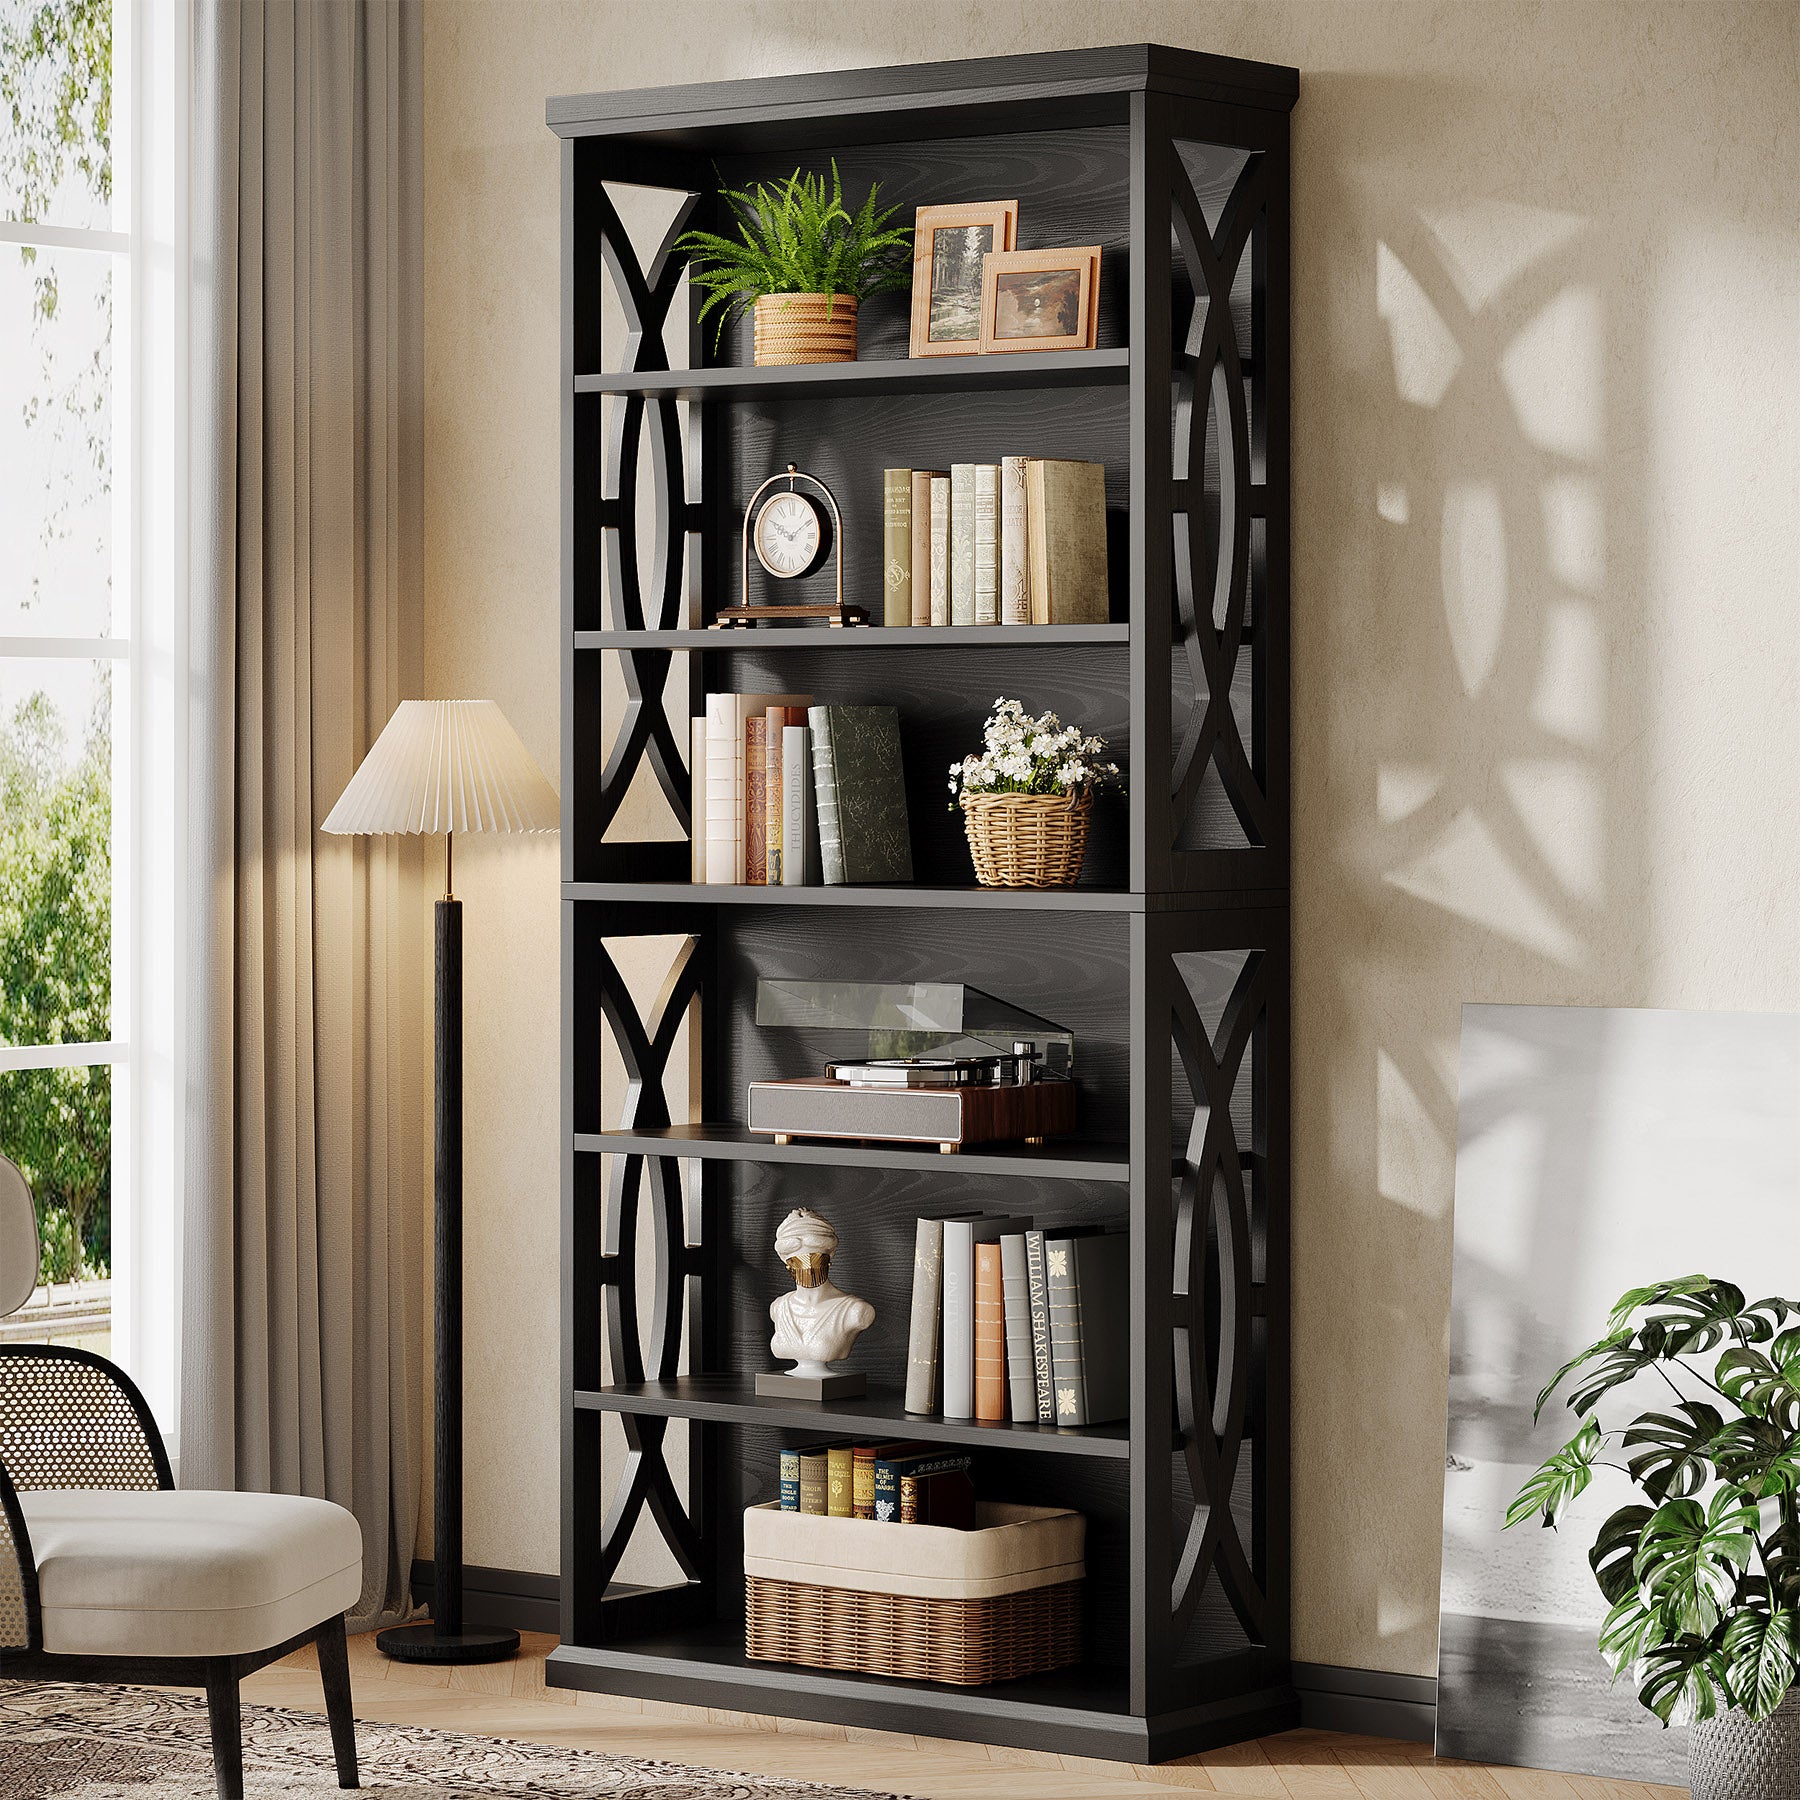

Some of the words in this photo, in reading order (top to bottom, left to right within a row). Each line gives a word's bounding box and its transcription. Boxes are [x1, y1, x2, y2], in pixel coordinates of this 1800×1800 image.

[791, 763, 801, 852] THUCYDIDES
[1028, 1234, 1044, 1307] WILLIAM
[1033, 1310, 1052, 1419] SHAKESPEARE
